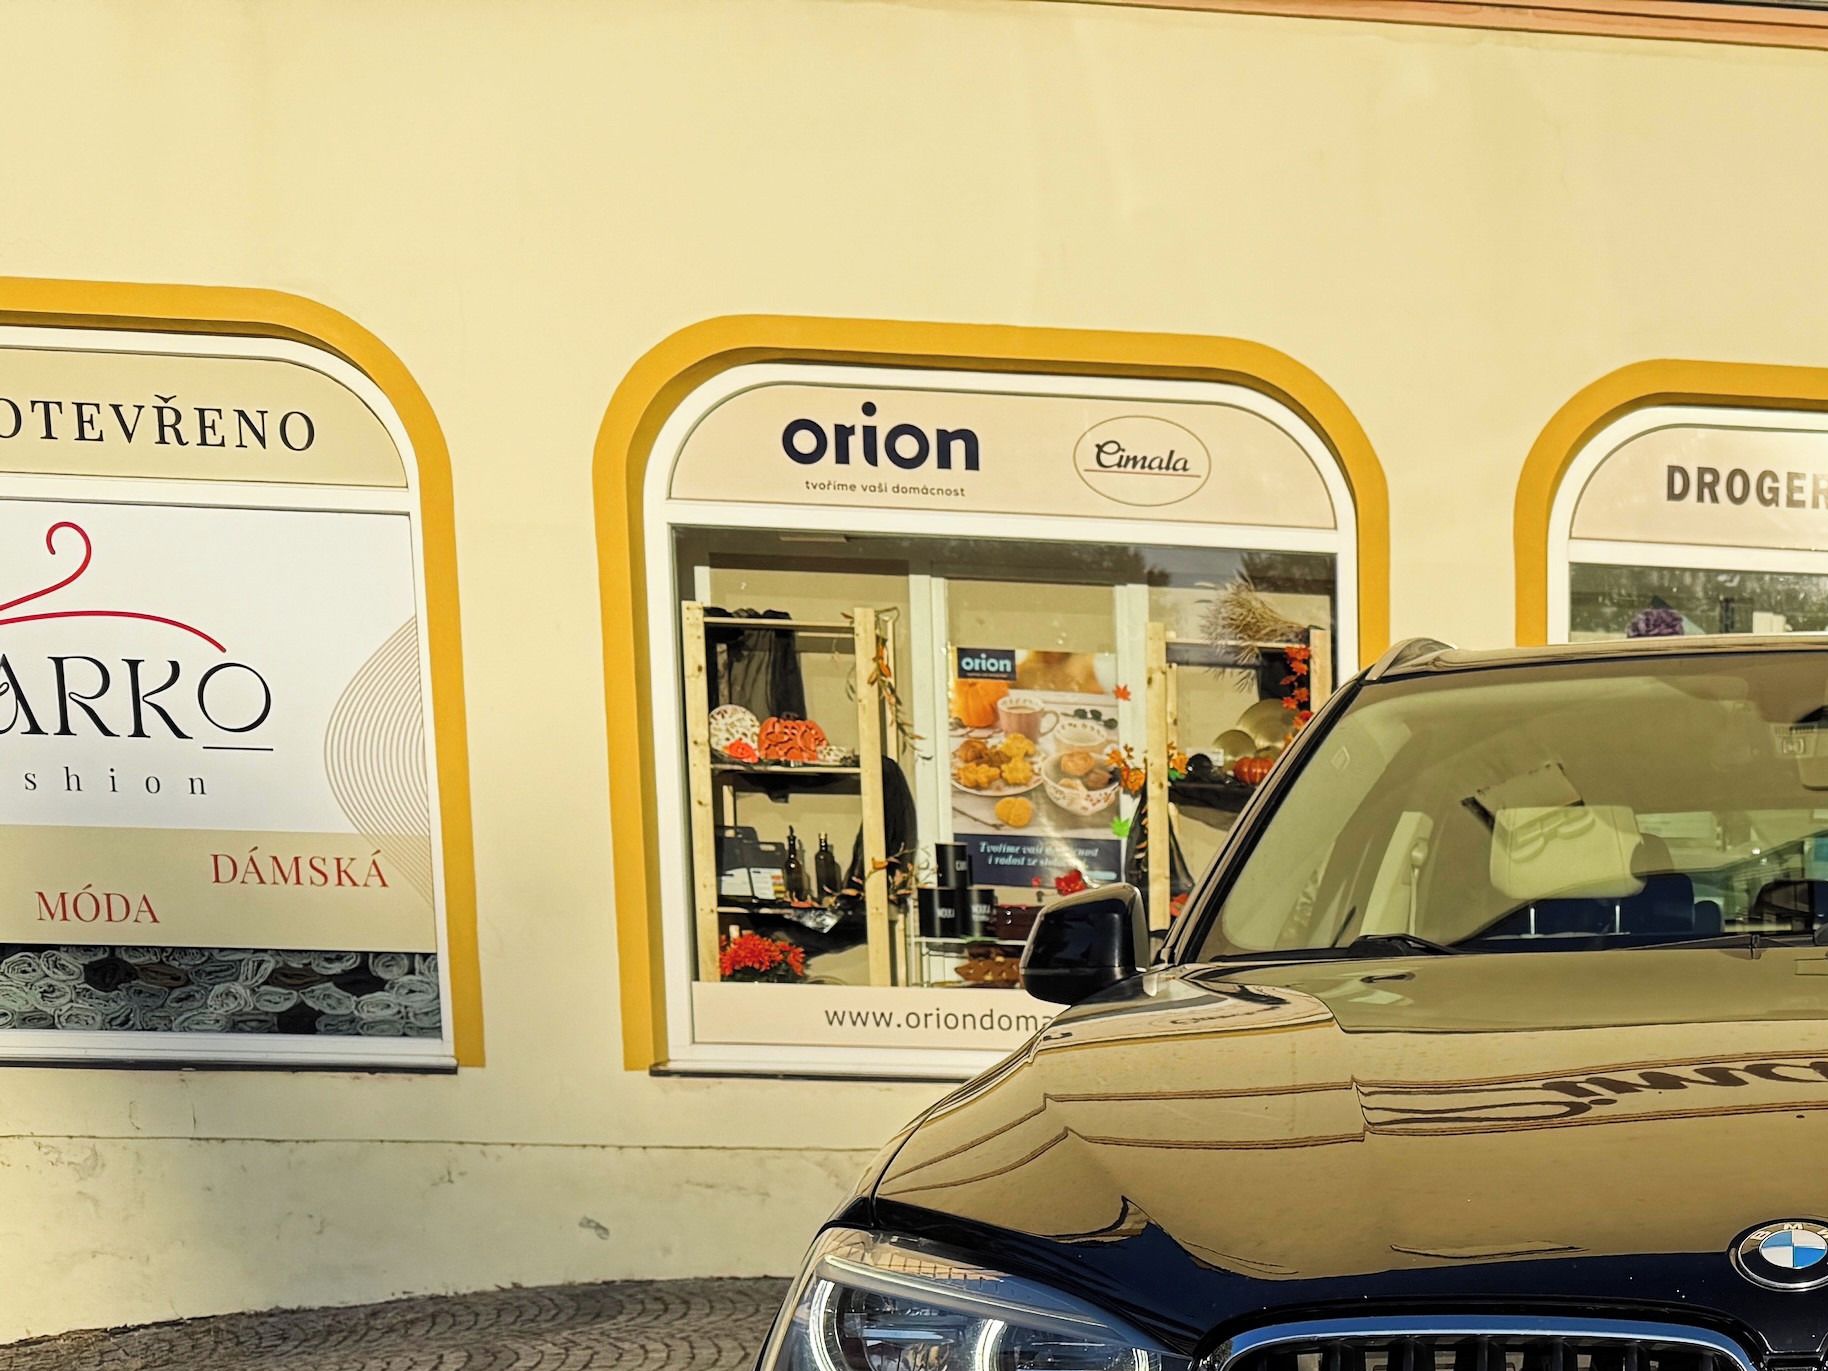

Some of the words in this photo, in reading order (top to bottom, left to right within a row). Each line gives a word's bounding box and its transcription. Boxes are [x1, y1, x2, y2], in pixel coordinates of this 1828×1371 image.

[0, 394, 315, 451] OTEVŘENO
[782, 401, 980, 471] orion
[1095, 440, 1190, 472] Cimala
[805, 480, 857, 492] tvoříme
[861, 482, 888, 493] vaši
[892, 484, 966, 497] domácnost
[961, 653, 1012, 672] orion
[210, 846, 389, 888] DÁMSKÁ
[35, 884, 160, 924] MÓDA
